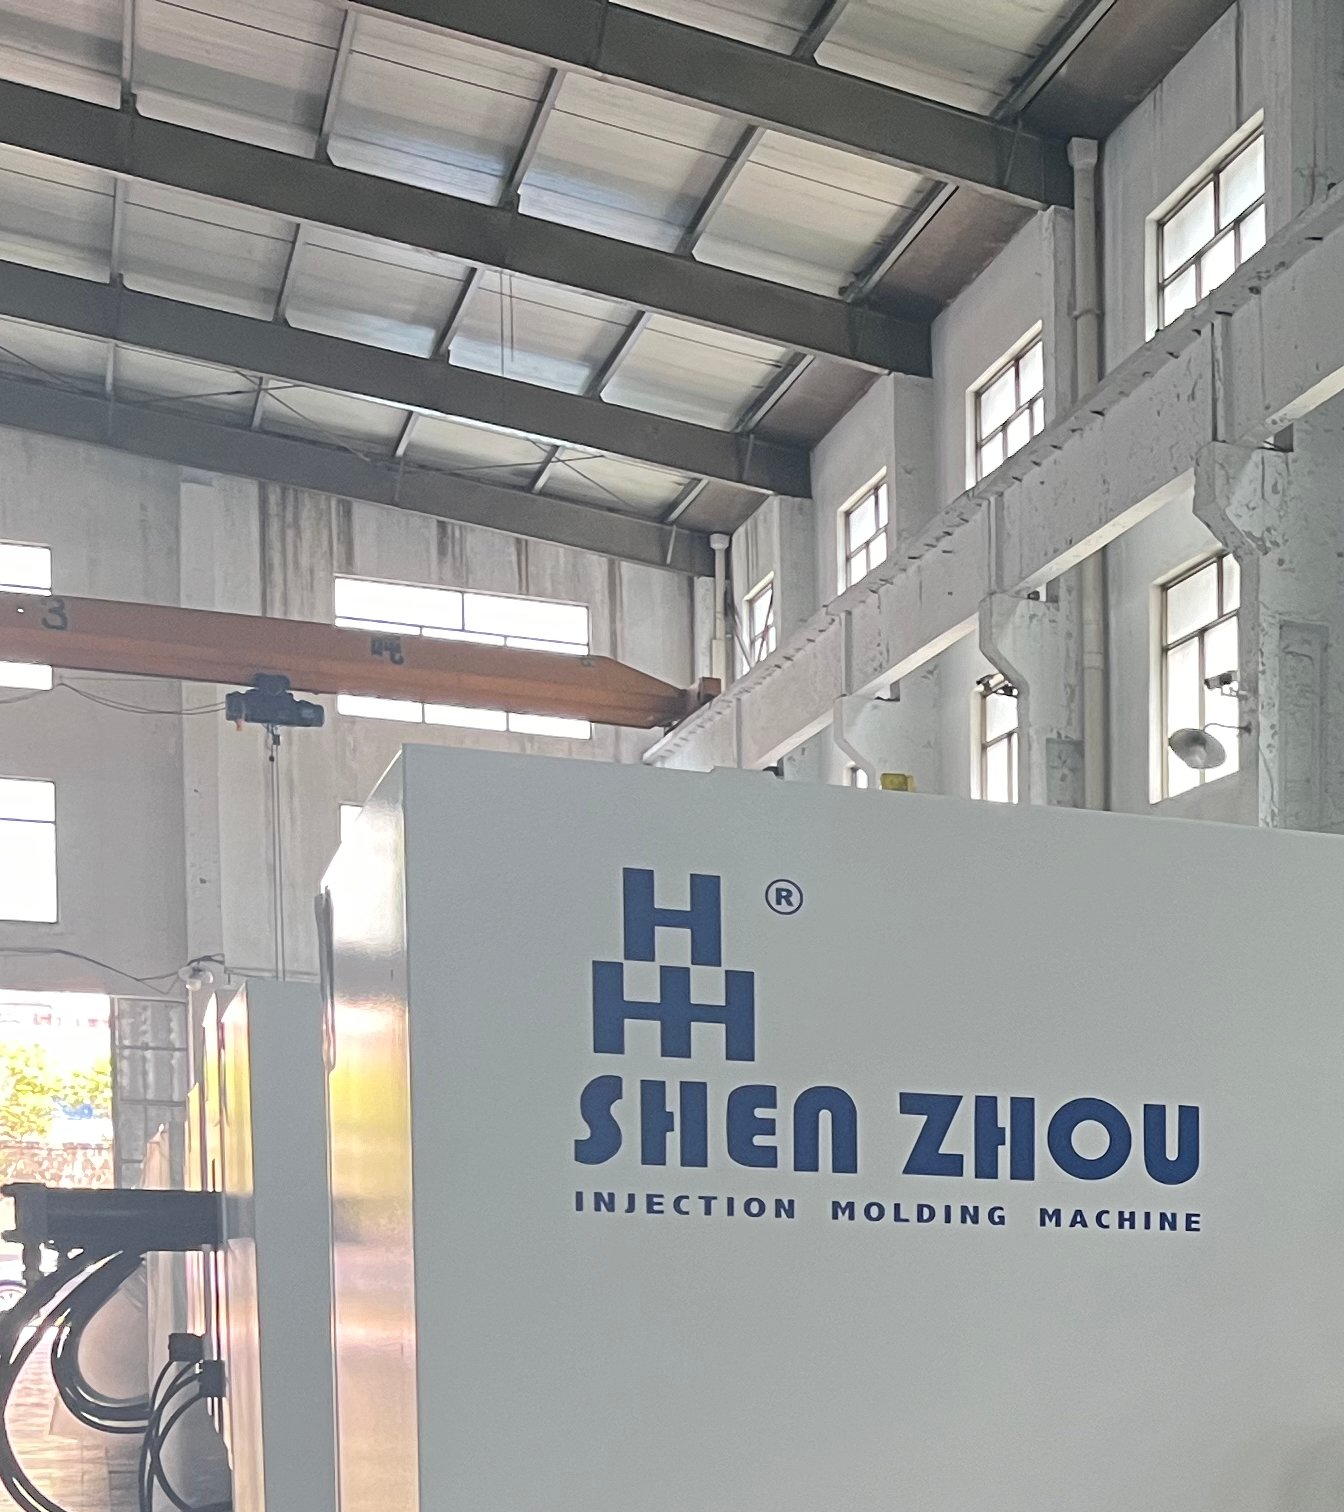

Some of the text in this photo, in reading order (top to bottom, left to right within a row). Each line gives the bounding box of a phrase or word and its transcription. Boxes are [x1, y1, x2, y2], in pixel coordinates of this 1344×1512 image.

[574, 1075, 1200, 1186] SHEN ZHOU
[575, 1191, 1202, 1232] INJECTION MOLDING MACHINE
